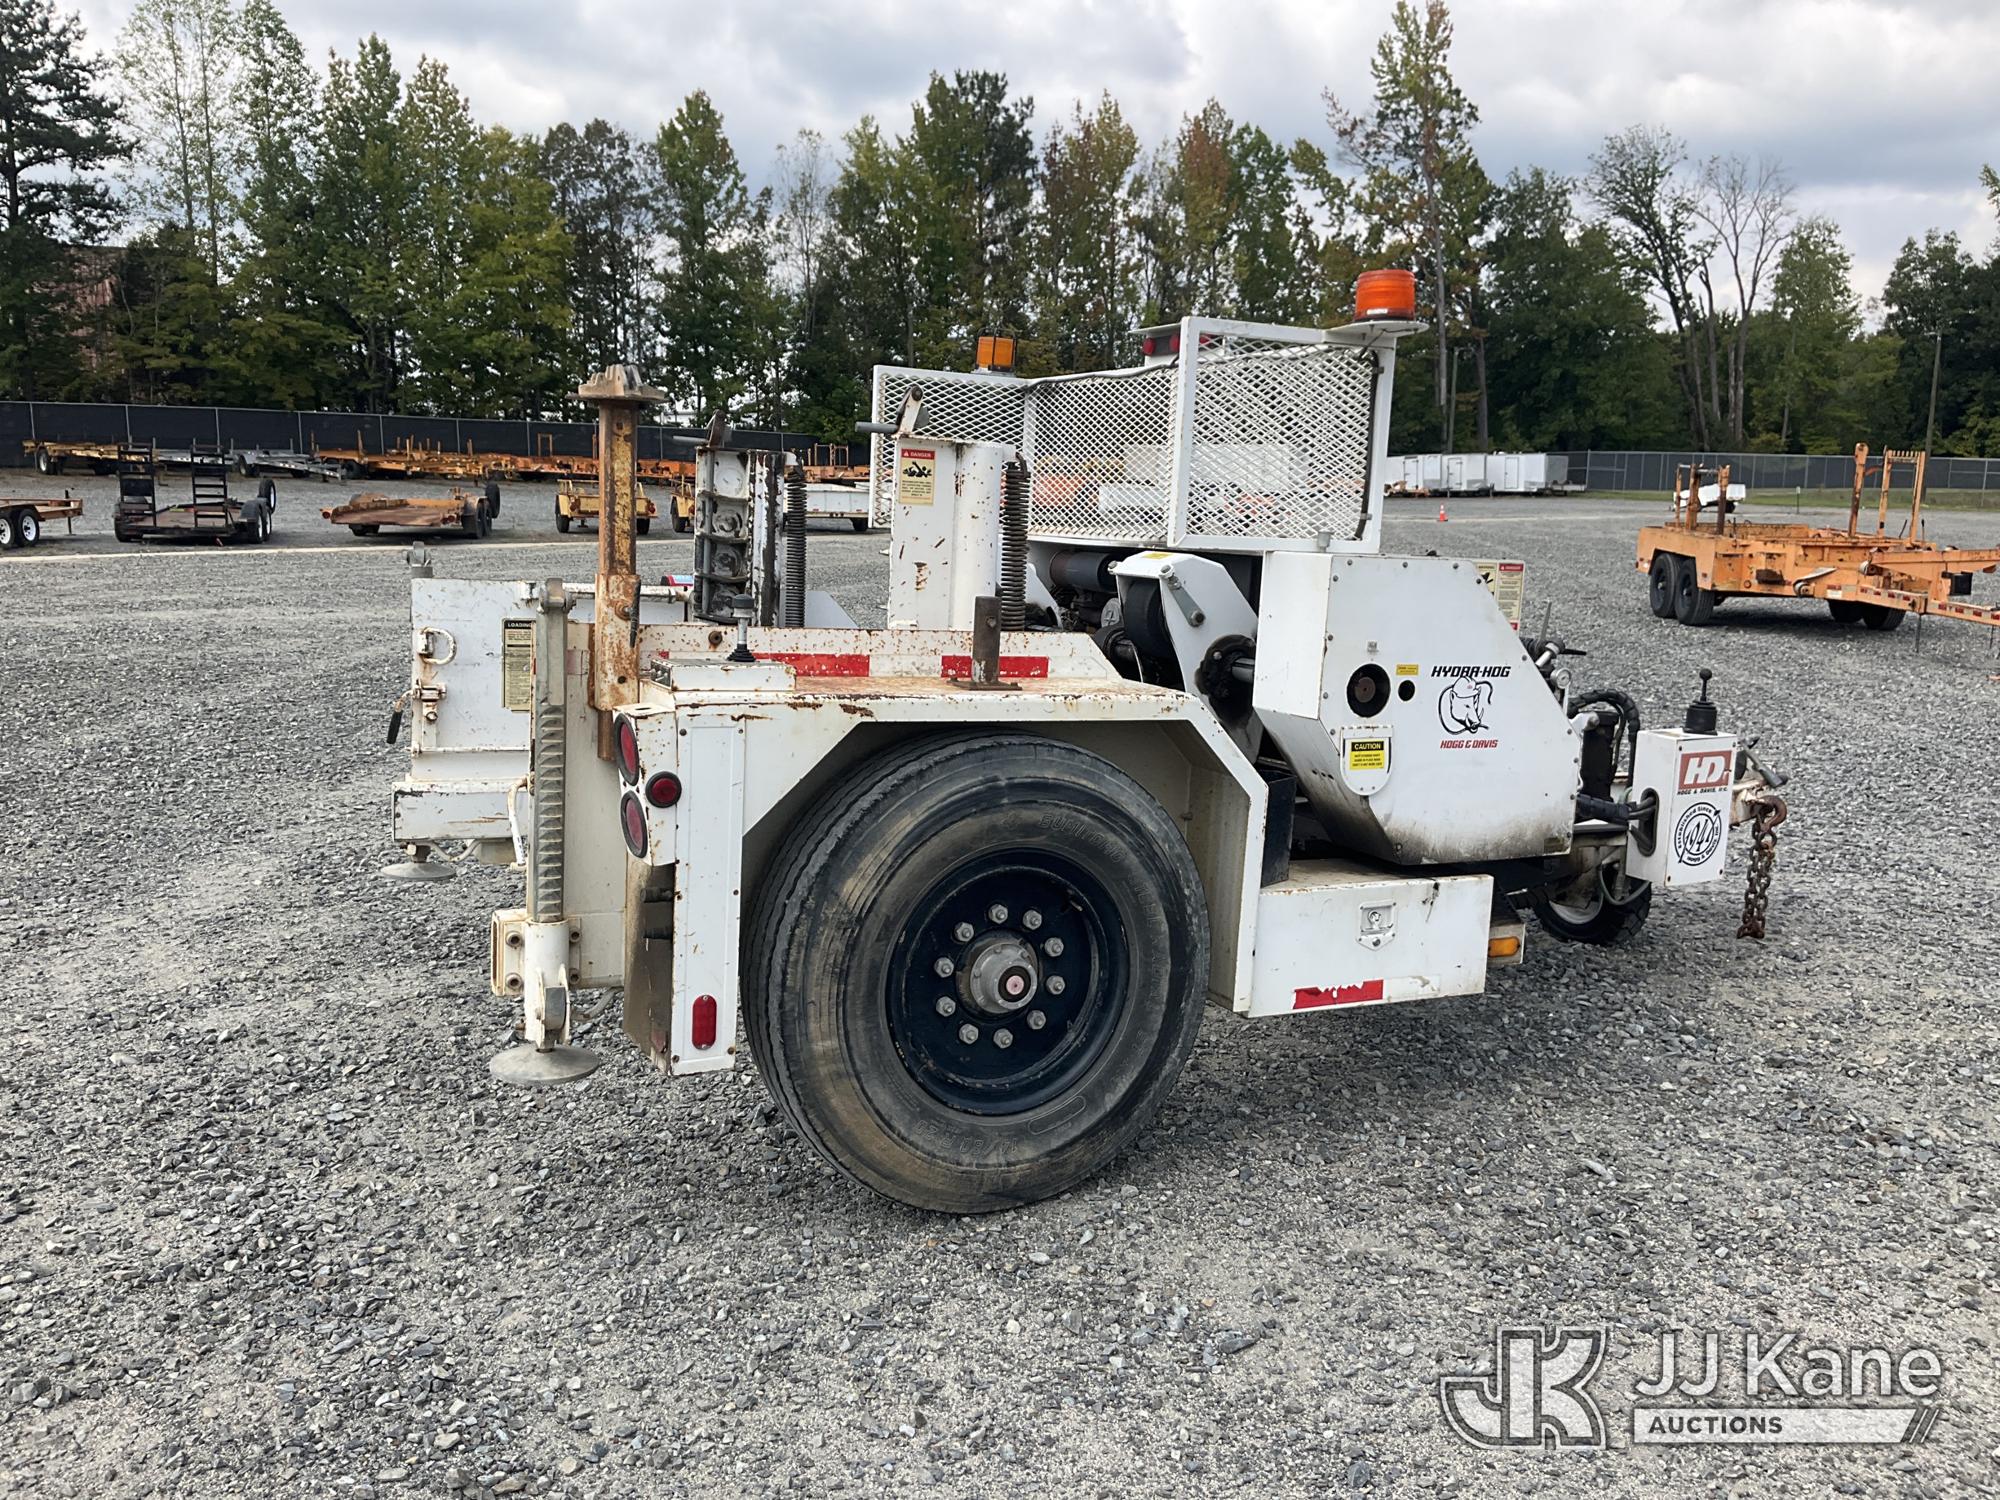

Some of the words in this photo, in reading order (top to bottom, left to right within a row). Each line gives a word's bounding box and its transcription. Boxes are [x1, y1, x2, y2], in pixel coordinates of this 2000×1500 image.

[1431, 666, 1511, 678] HYDRA-HOG
[1440, 740, 1464, 749] HOGG
[1472, 739, 1498, 749] DAVIS
[1683, 755, 1726, 785] HD
